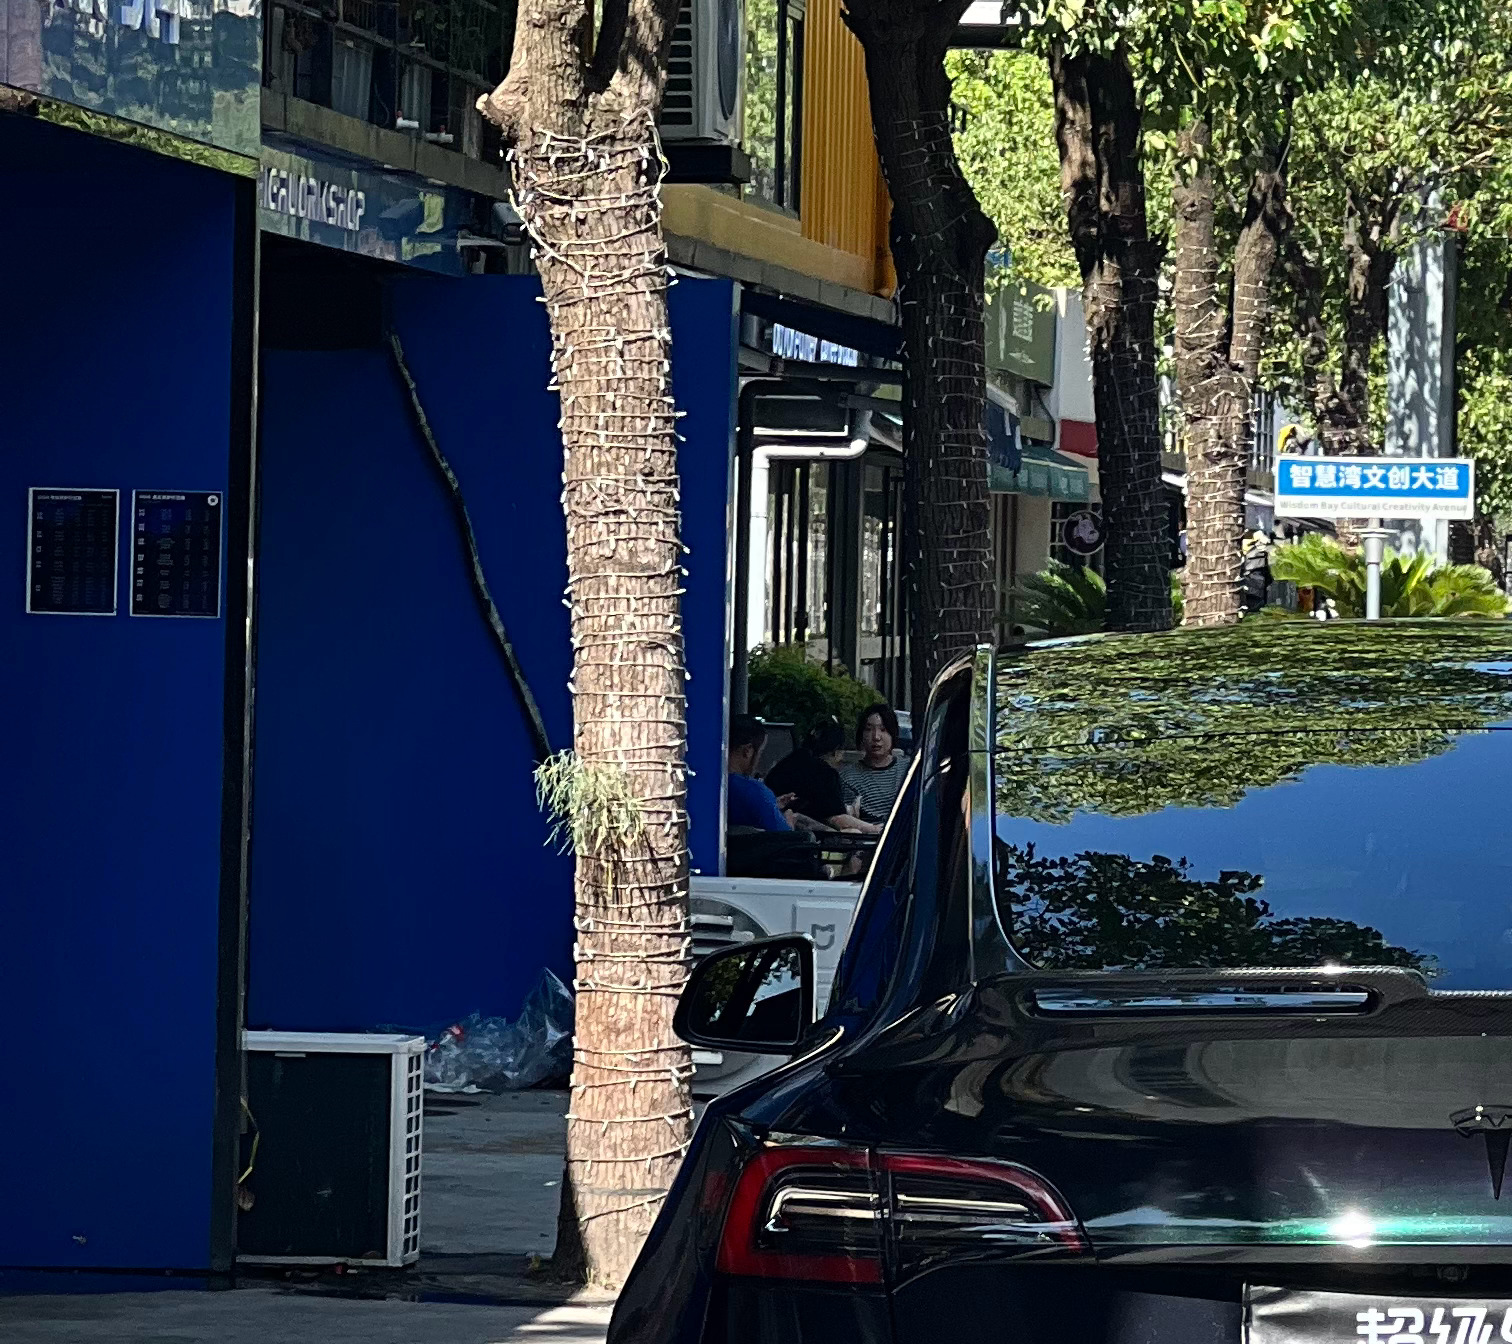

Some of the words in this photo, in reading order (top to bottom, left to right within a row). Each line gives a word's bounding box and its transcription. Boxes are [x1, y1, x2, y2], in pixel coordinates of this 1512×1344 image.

[1289, 464, 1460, 491] 智慧湾文创大道
[1280, 500, 1319, 509] Wisdom
[1321, 501, 1339, 512] Bay
[1341, 502, 1380, 511] Cultural
[1382, 502, 1431, 514] Creativity
